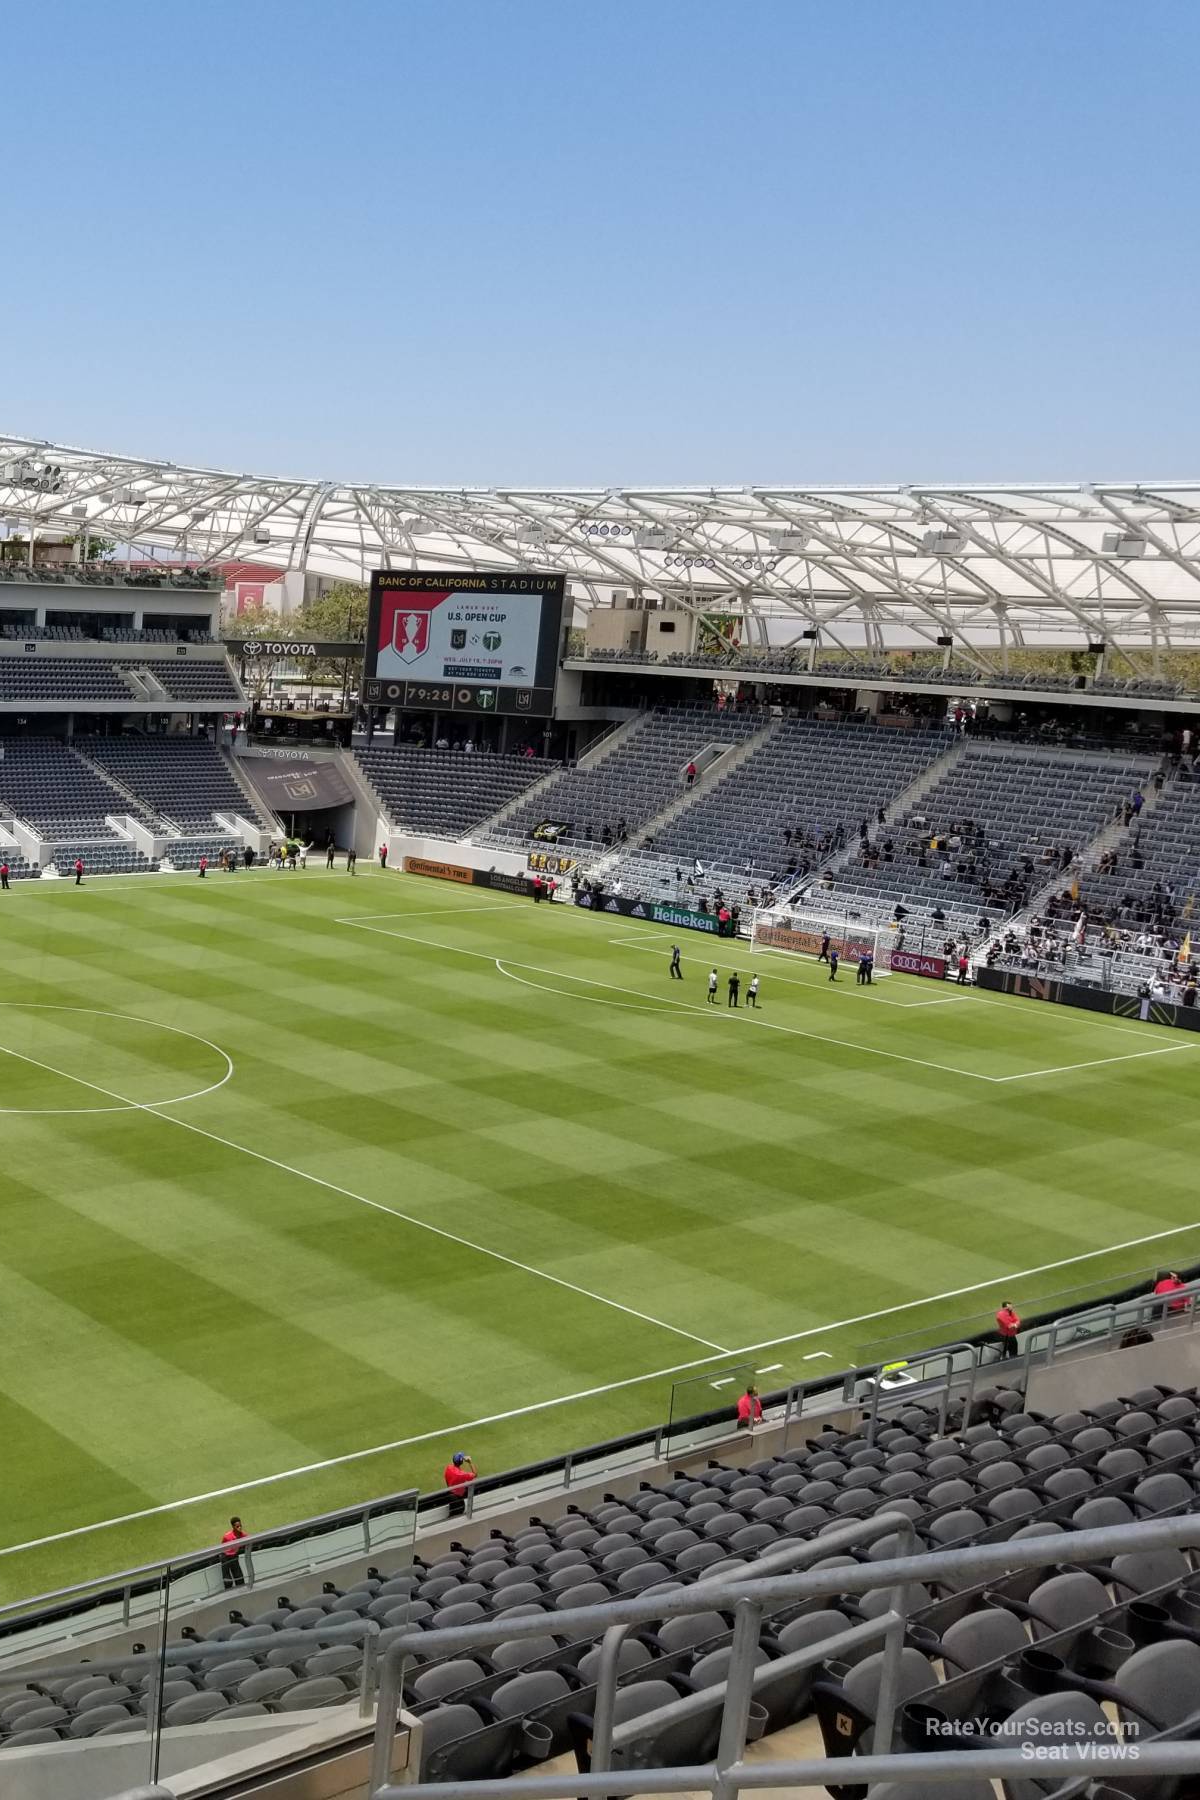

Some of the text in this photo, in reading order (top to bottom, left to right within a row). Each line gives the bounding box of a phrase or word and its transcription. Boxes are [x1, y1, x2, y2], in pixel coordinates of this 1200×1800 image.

[378, 577, 557, 590] BANC OF CALIFORNIA STADIUM
[465, 613, 487, 622] OPEN
[489, 614, 507, 622] CUP
[265, 643, 316, 655] TOYOTA
[408, 688, 450, 701] 79:28
[273, 750, 309, 760] TOYOTA
[653, 907, 714, 931] Heineken
[841, 1719, 848, 1730] K
